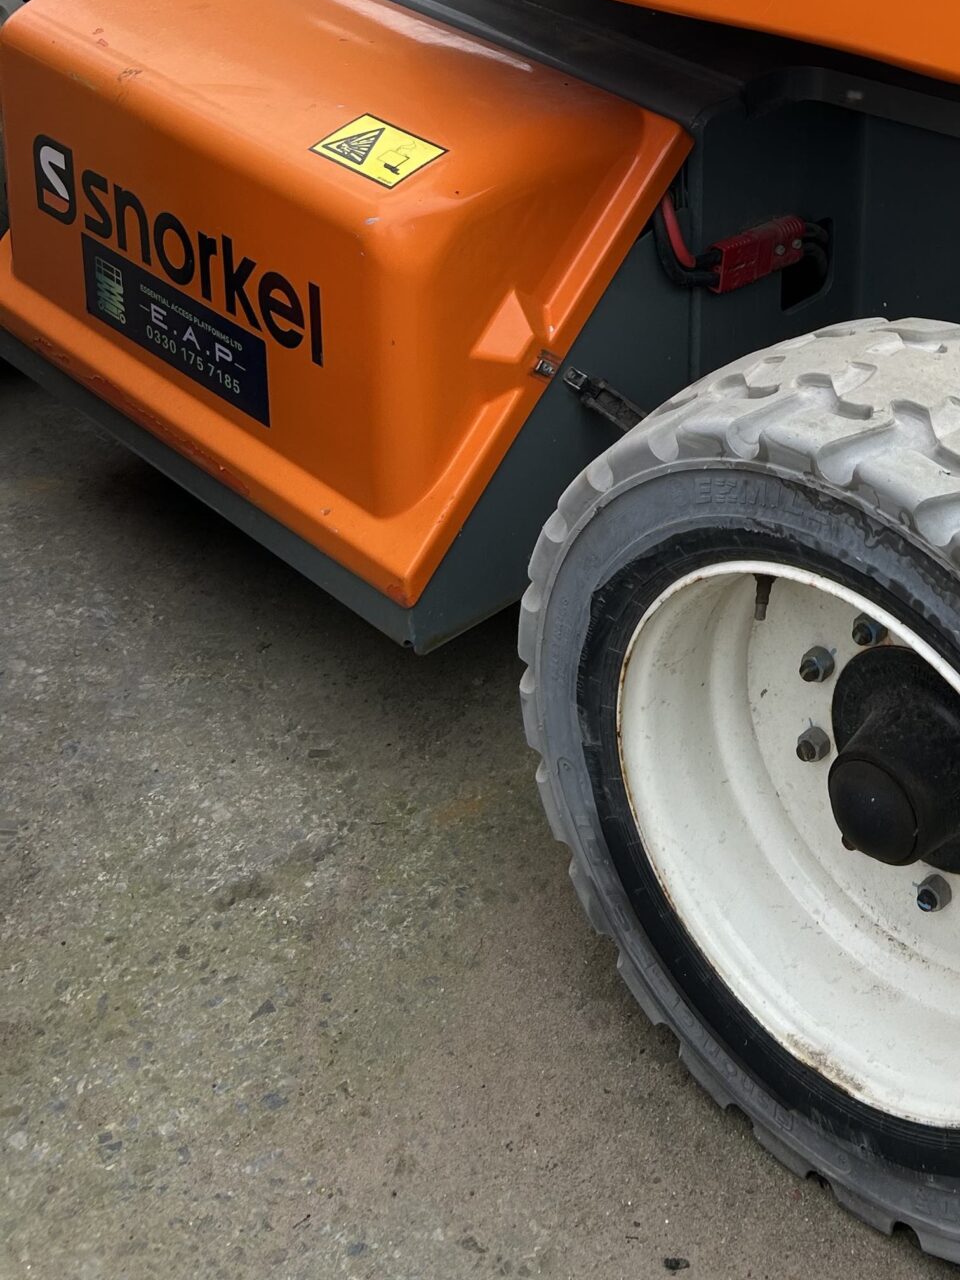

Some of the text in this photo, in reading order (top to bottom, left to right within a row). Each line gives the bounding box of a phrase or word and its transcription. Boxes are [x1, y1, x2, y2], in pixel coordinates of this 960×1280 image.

[81, 169, 324, 368] snorkel
[140, 283, 243, 352] ESSENTIAL ACCESS PLATFORMS LTD
[146, 325, 241, 394] 0330 175 7185
